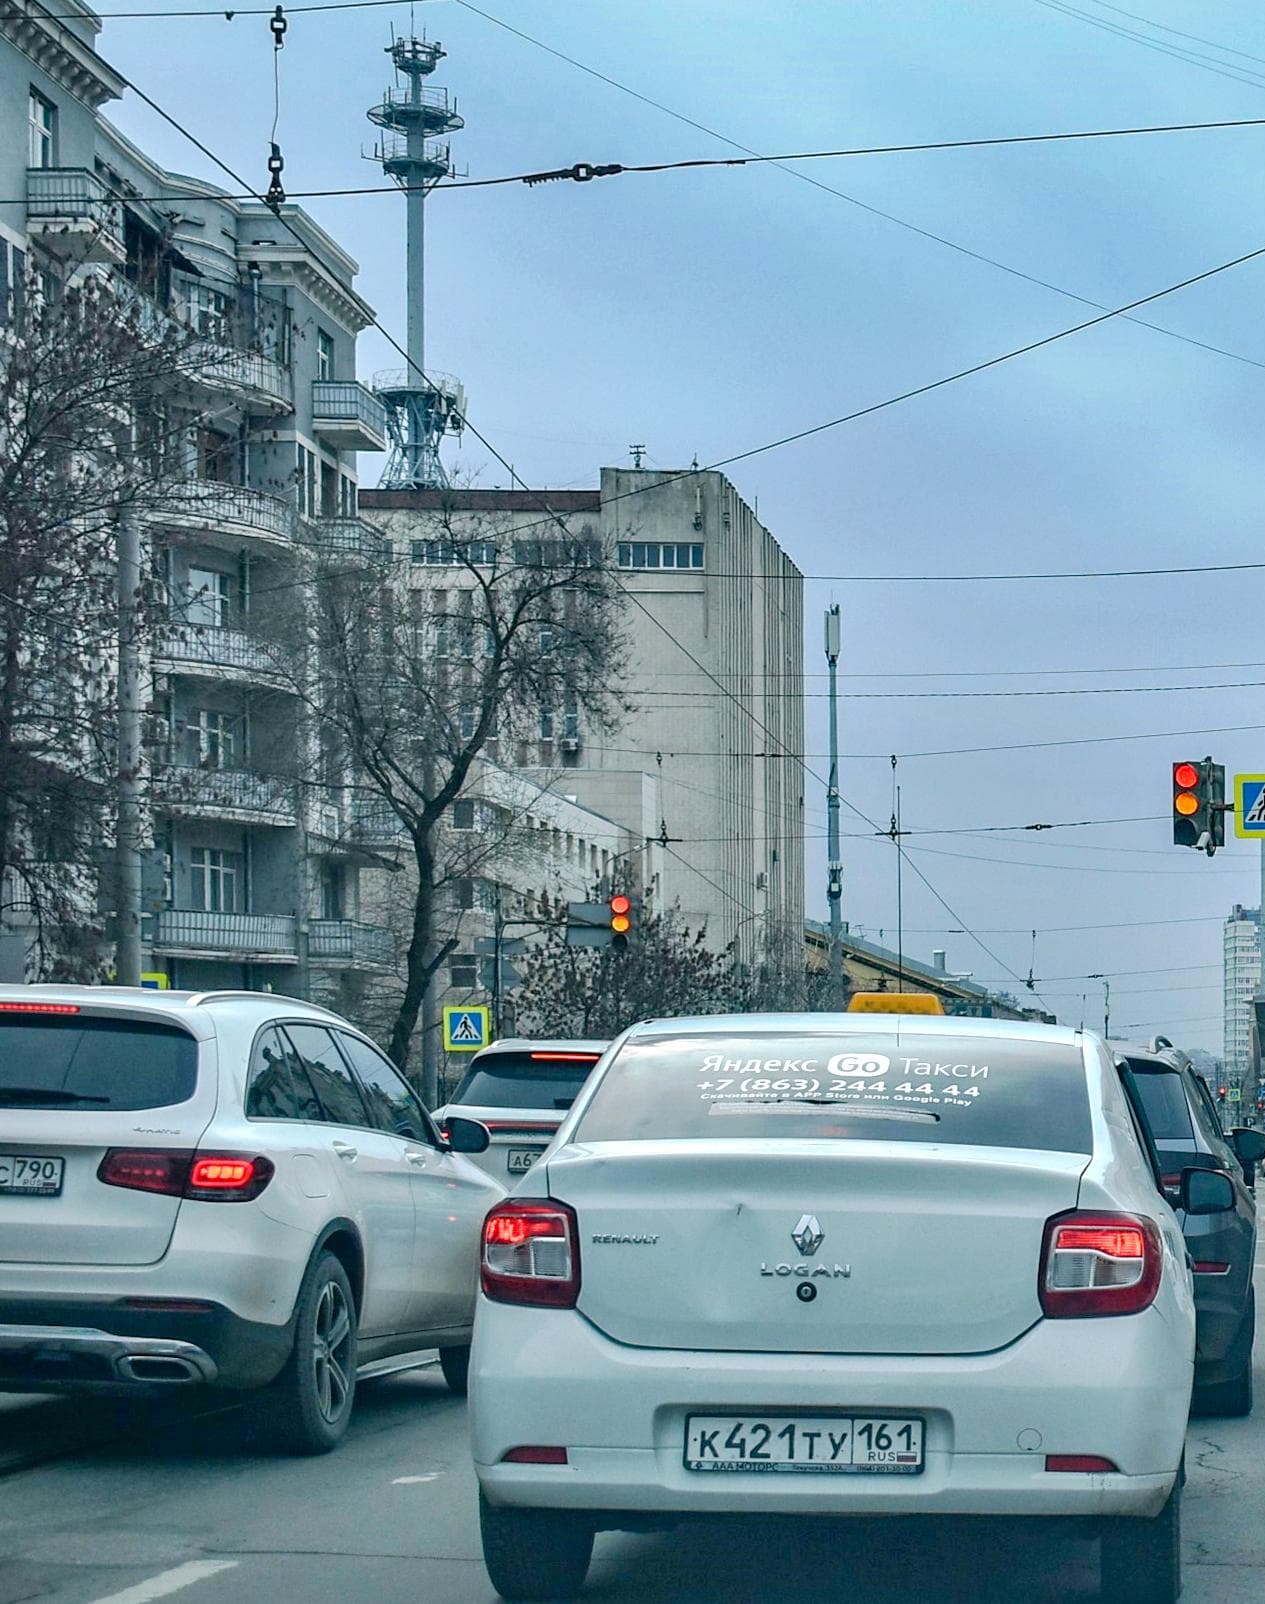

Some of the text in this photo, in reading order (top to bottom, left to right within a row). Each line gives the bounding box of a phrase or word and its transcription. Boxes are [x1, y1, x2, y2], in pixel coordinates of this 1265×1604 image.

[699, 1055, 989, 1079] Яндекс Go Такси
[696, 1078, 981, 1098] +7 (863) 244 44 44
[700, 1091, 778, 1100] Скачивайте
[893, 1093, 940, 1104] Google
[944, 1097, 972, 1107] Play
[16, 1160, 55, 1179] 790
[591, 1233, 661, 1245] RENAULT
[760, 1262, 852, 1278] LOGAN
[858, 1423, 912, 1451] 161
[868, 1451, 896, 1462] RUS
